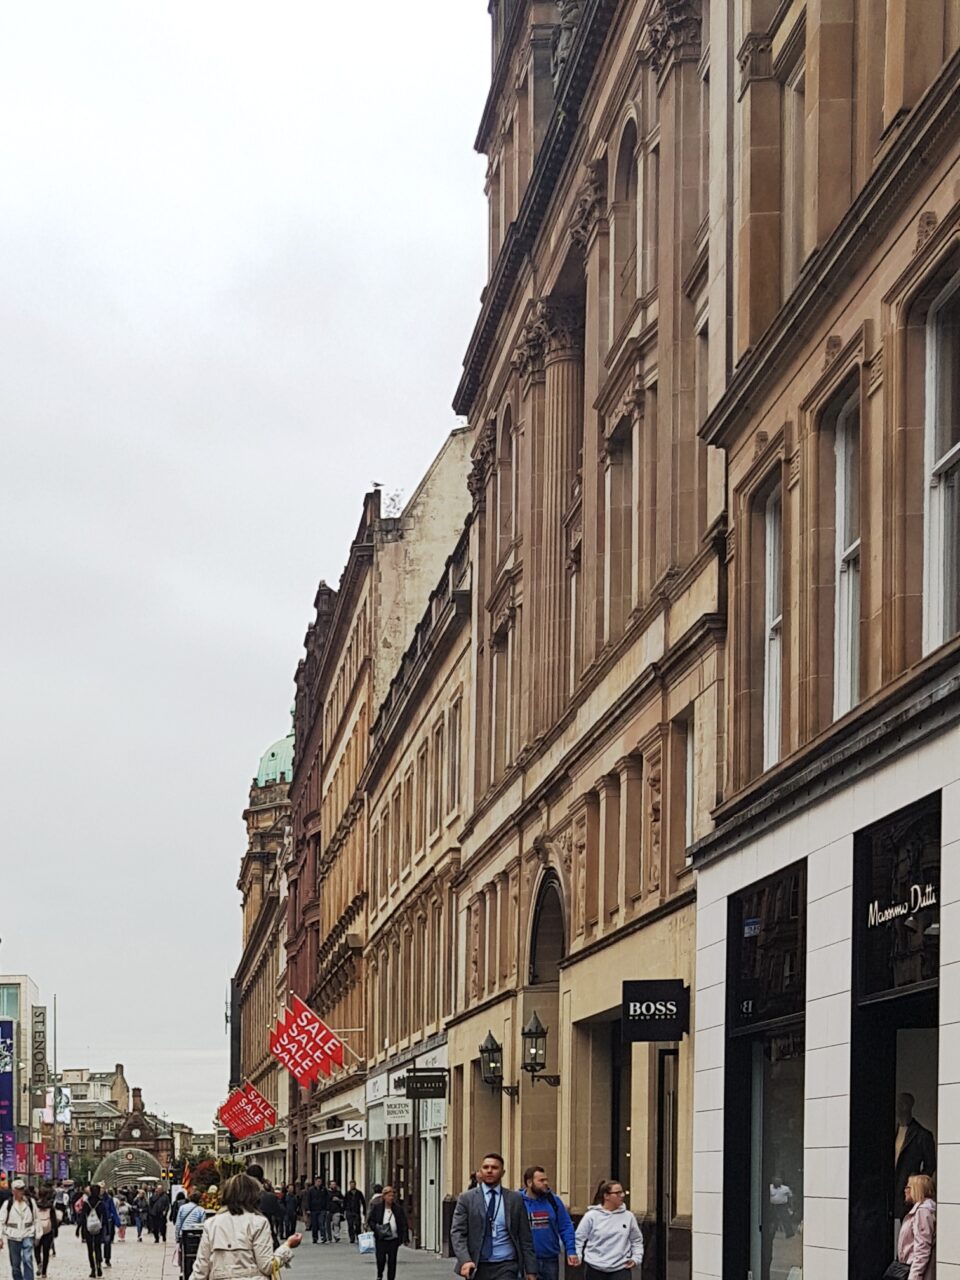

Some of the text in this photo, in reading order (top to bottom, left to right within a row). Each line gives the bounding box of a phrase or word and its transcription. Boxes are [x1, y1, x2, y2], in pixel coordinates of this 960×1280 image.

[868, 884, 936, 928] Massimo Dutti
[629, 1001, 677, 1015] BOSS
[34, 1011, 45, 1083] ST ENOCH
[279, 1033, 314, 1071] SALE
[288, 1023, 325, 1063] SALE
[297, 1011, 341, 1056] SALE
[272, 1043, 305, 1078] SALE
[239, 1097, 264, 1124] SALE
[247, 1090, 274, 1118] SALE
